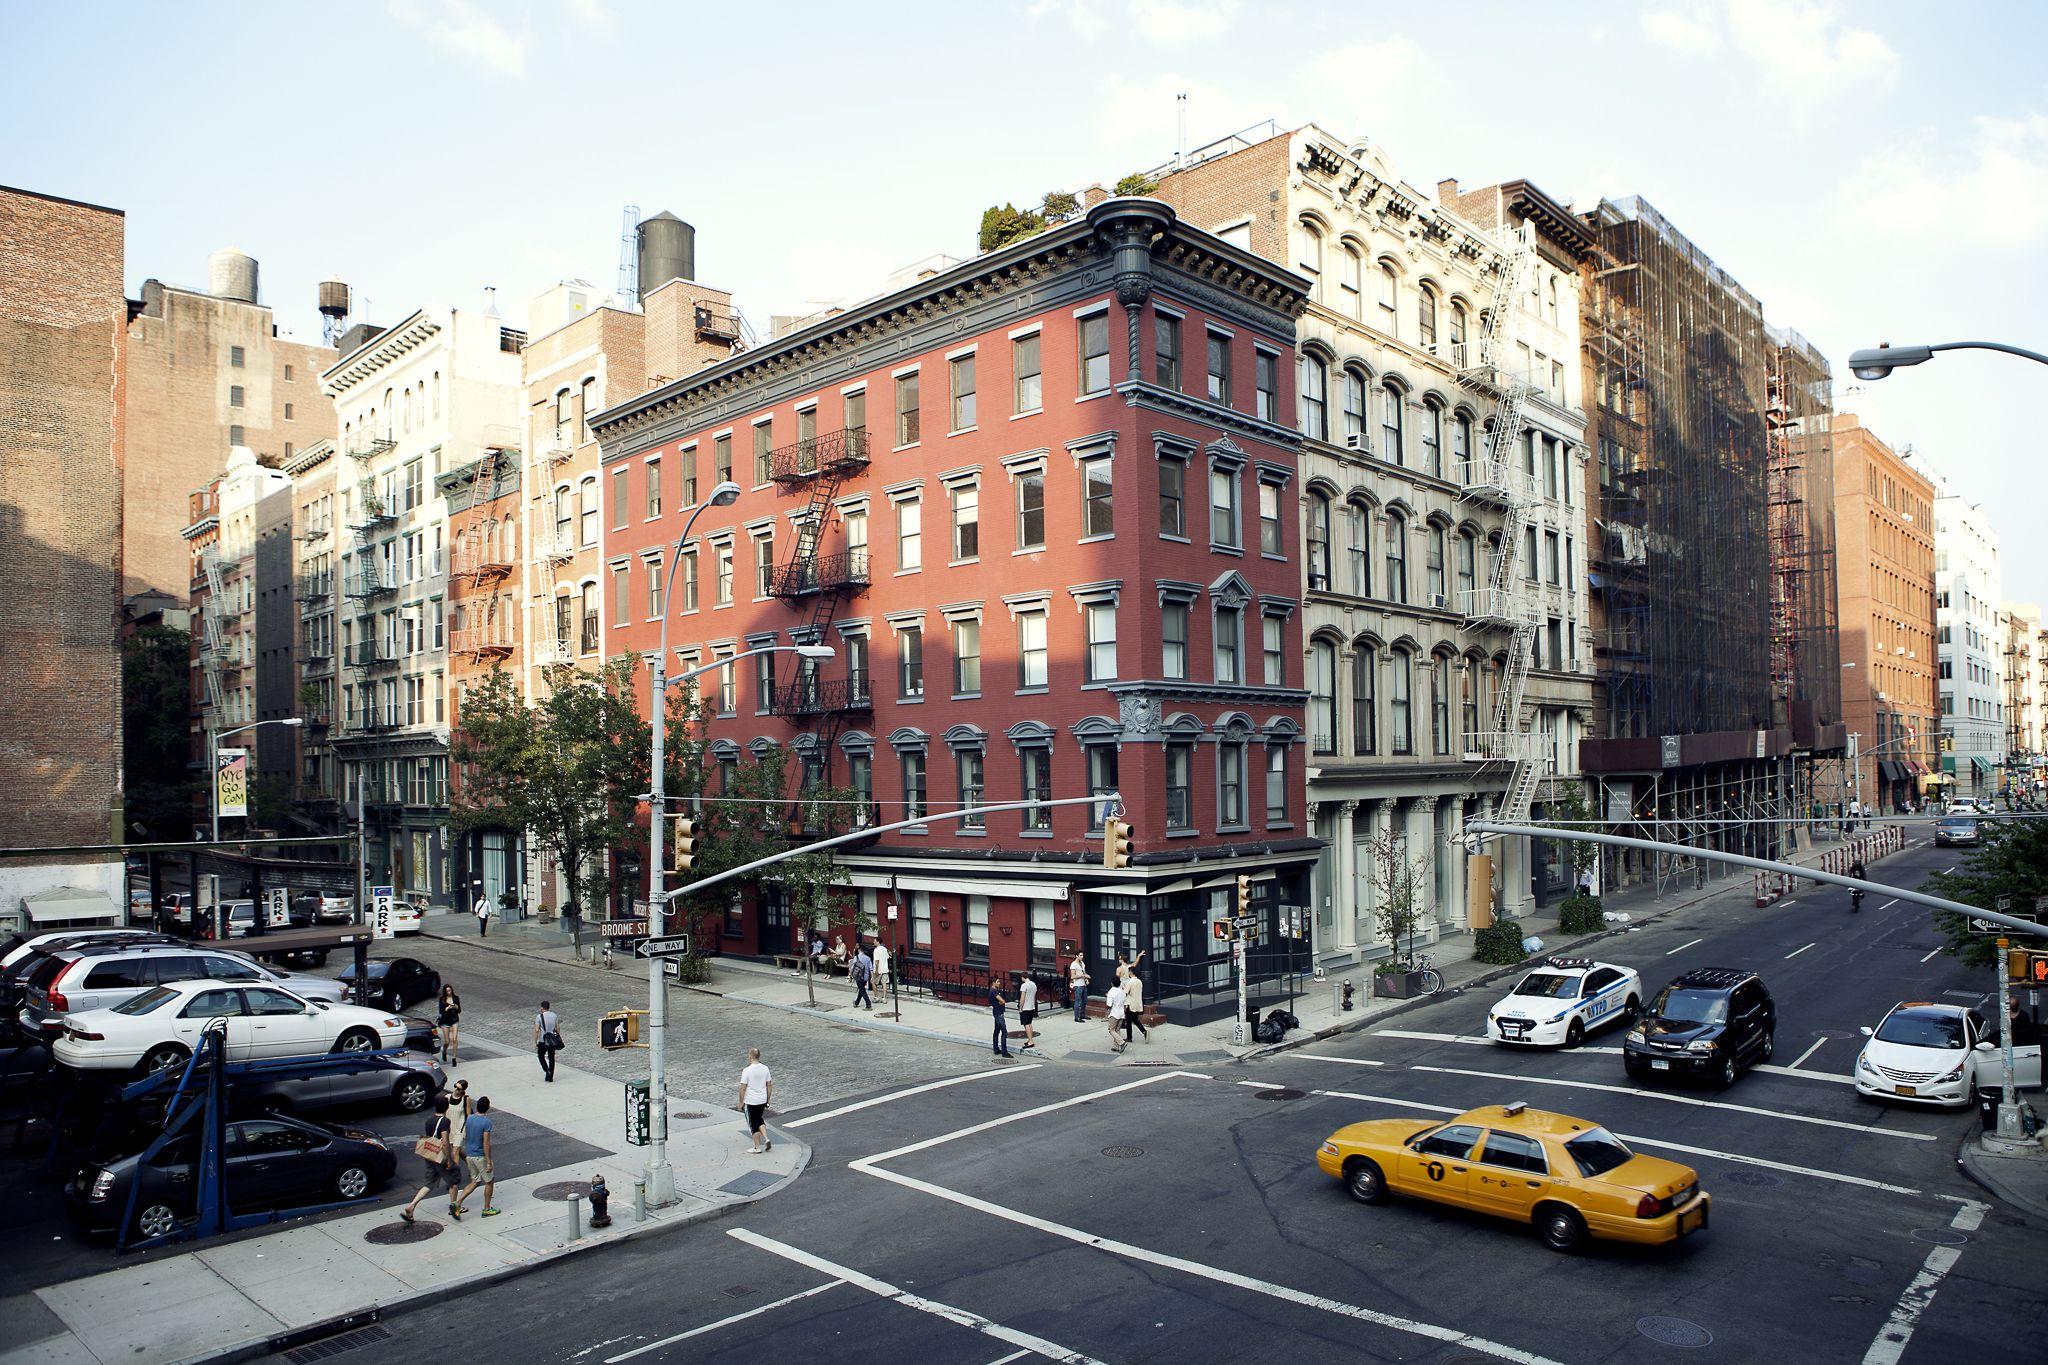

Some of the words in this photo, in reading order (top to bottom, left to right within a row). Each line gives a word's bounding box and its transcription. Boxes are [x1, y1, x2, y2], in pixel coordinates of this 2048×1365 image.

[221, 769, 242, 782] NYC
[274, 890, 284, 916] PARK
[378, 897, 388, 928] PARK
[601, 923, 634, 936] BROOME
[637, 922, 647, 935] ST
[642, 943, 658, 953] ONE
[665, 941, 681, 951] WAY
[665, 963, 676, 972] WAY
[1591, 1000, 1608, 1017] NYPD
